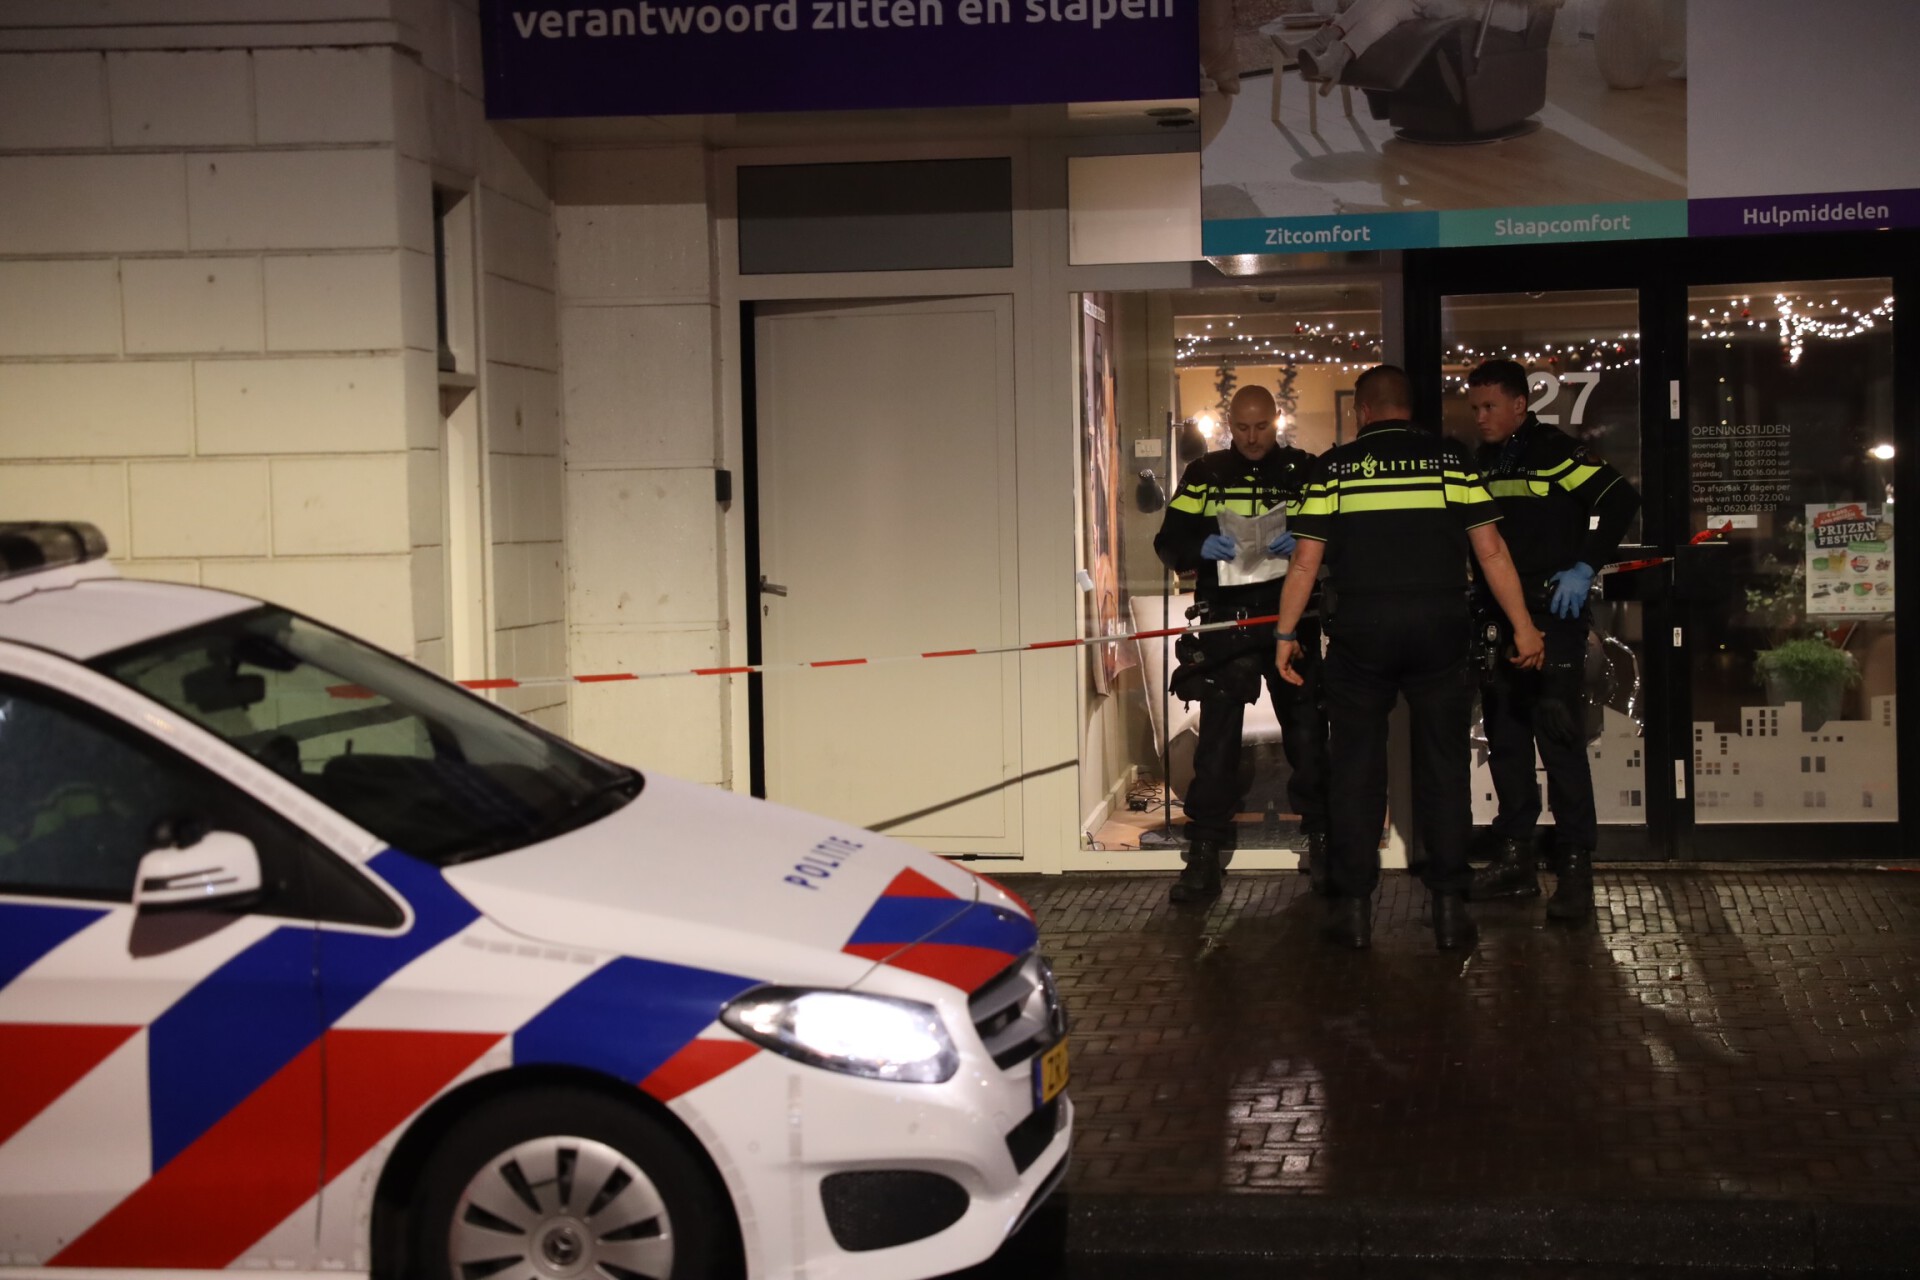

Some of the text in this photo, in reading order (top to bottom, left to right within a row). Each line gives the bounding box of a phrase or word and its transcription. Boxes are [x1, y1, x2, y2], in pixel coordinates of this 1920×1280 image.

[512, 0, 1174, 39] verantwoord zitten en slapen
[1743, 202, 1889, 227] Hulpmiddelen
[1494, 214, 1631, 237] Slaapcomfort
[1264, 225, 1371, 245] Zitcomfort
[1526, 371, 1601, 425] 27
[1691, 425, 1791, 435] OPENINGSTIJDEN
[1351, 456, 1428, 477] POLITIE
[1692, 461, 1716, 469] vrijdag
[1692, 470, 1723, 478] zaterdag
[1692, 485, 1705, 493] Op
[1743, 483, 1748, 491] 7
[1749, 484, 1774, 492] dagen
[1776, 485, 1791, 493] per
[1692, 495, 1714, 503] week
[1732, 493, 1784, 502] 10.00-22.00
[1706, 503, 1777, 513] Bel: 0620 412 331
[1818, 521, 1876, 536] PRIJZEN
[1819, 532, 1877, 546] FESTIVAL
[784, 836, 864, 890] POLITIE
